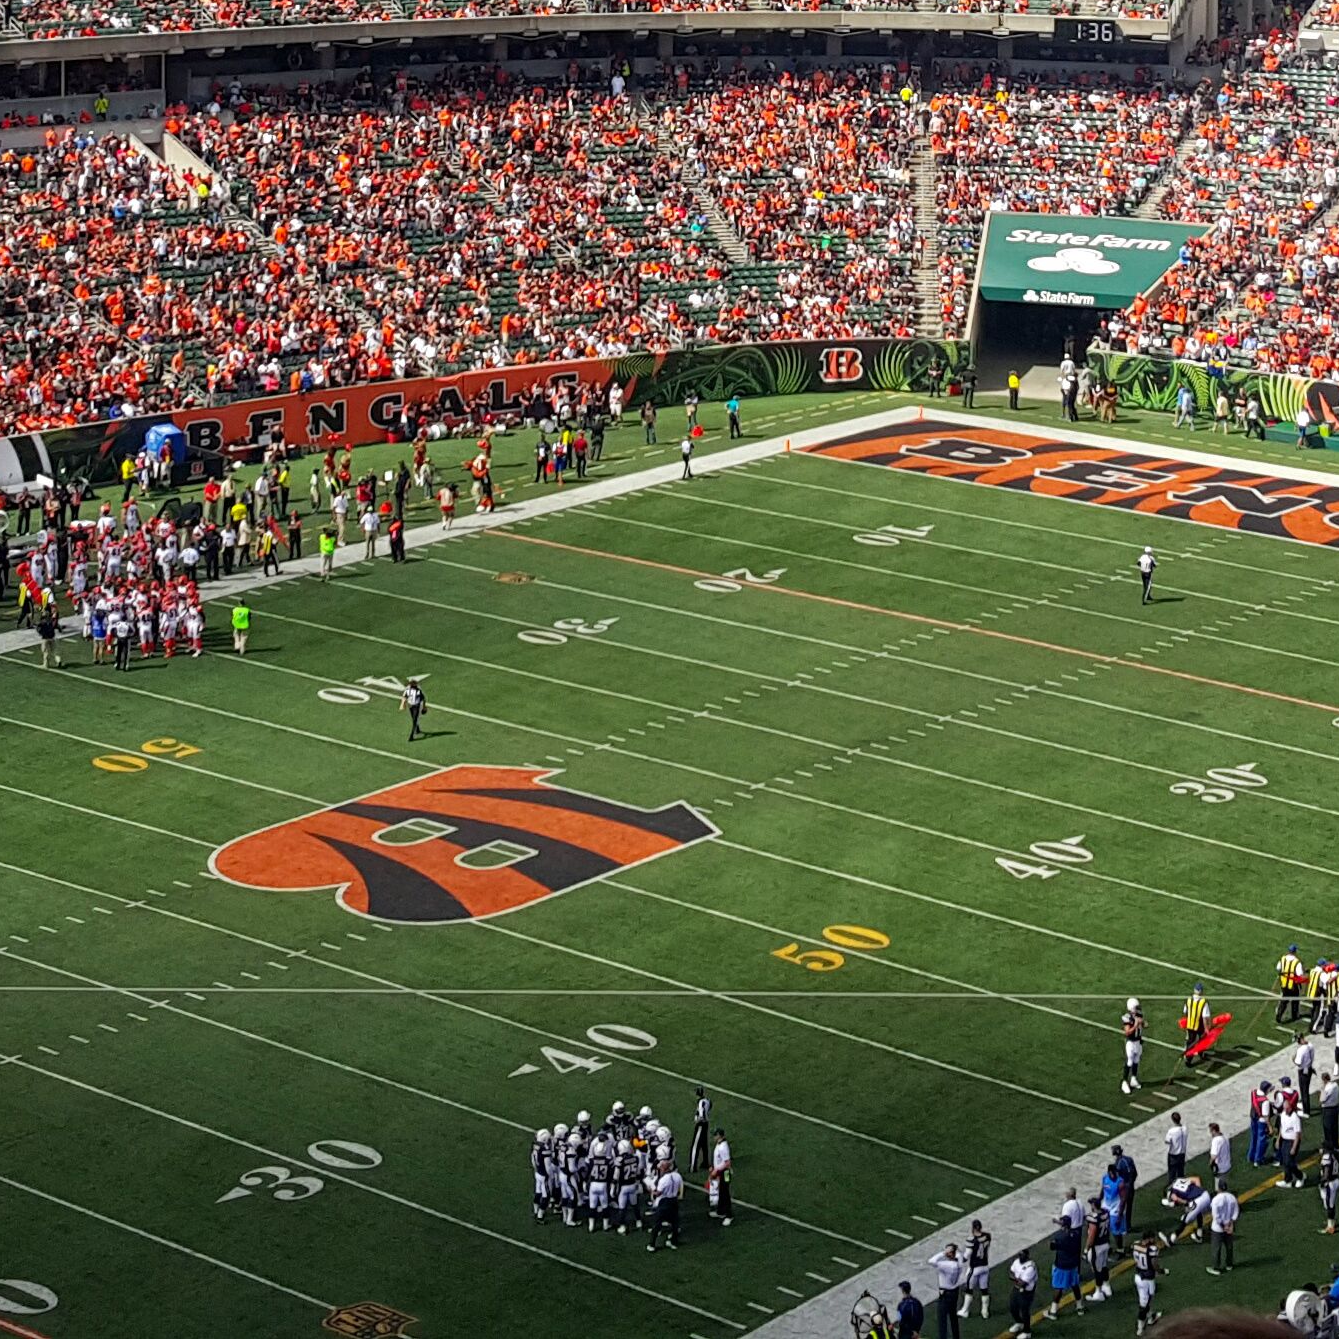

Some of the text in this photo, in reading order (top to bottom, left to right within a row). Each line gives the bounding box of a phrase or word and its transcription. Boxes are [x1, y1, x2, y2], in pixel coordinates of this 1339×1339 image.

[1077, 22, 1113, 42] 1:36
[852, 524, 929, 547] 10
[694, 566, 782, 593] 20
[517, 617, 610, 646] 30
[317, 675, 407, 705] 40
[91, 738, 205, 774] 50
[1169, 766, 1269, 804] 30
[994, 837, 1094, 882] 40
[771, 924, 891, 972] 50
[534, 1022, 660, 1076] 40
[238, 1138, 384, 1203] 30
[590, 1164, 608, 1180] 43
